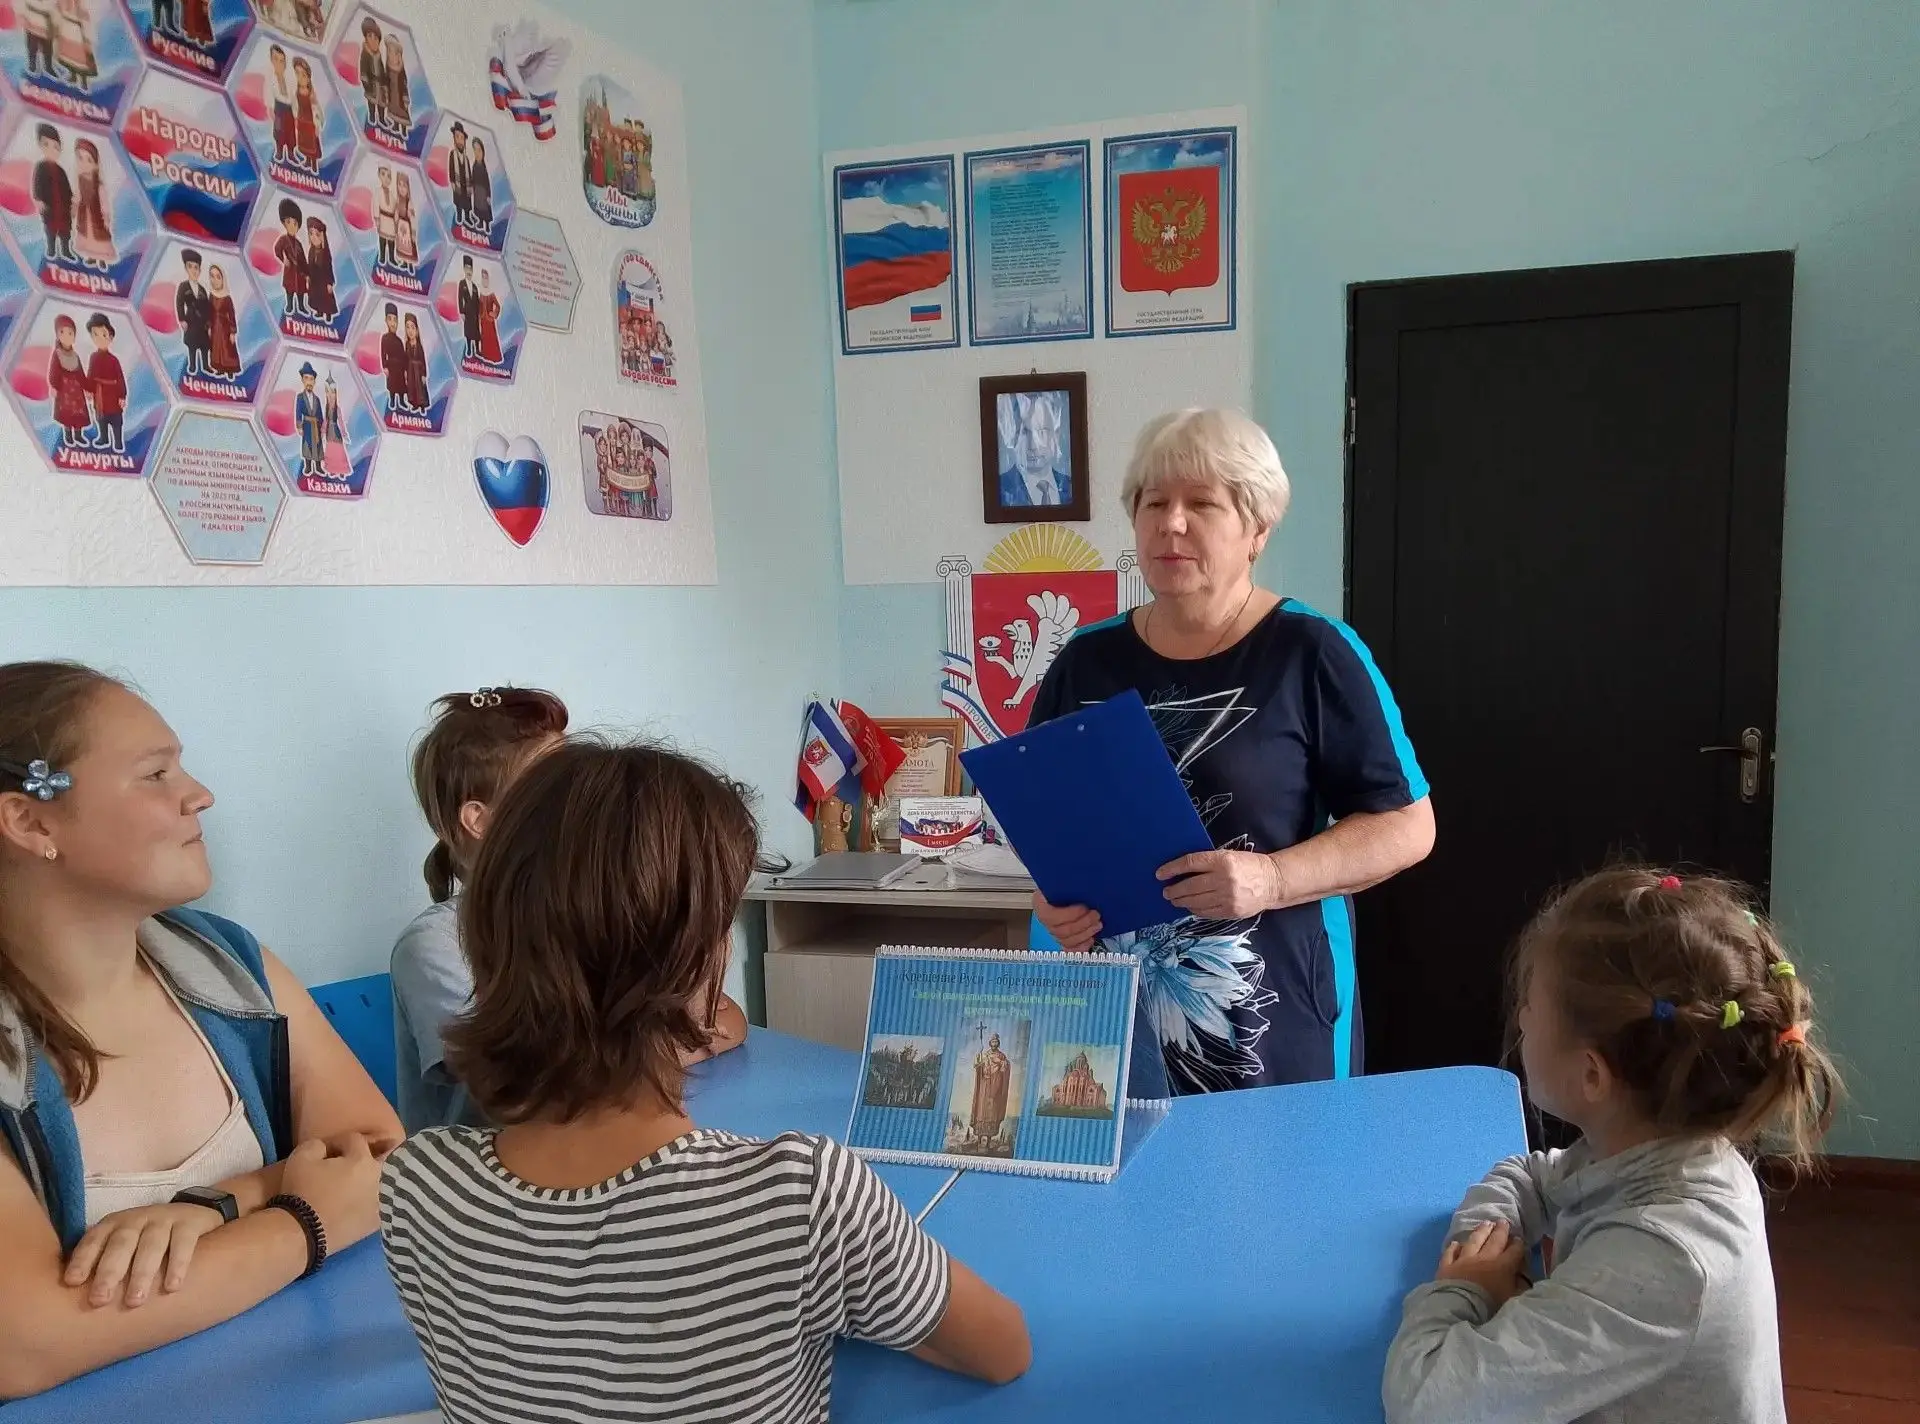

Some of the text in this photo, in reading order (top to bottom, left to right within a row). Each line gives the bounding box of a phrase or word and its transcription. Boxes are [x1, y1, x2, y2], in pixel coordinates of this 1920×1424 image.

[152, 31, 216, 70] Русские
[140, 106, 236, 161] Народы
[150, 153, 236, 199] России
[606, 187, 628, 207] Мы
[462, 226, 490, 245] Евреи
[46, 264, 117, 293] Татары
[376, 266, 422, 290] Чуваши
[286, 317, 340, 340] Грузины
[183, 376, 247, 398] Чеченцы
[392, 412, 432, 428] Армяне
[58, 448, 134, 470] Удмурты
[307, 478, 350, 494] Казахи
[904, 759, 934, 768] АМОТА
